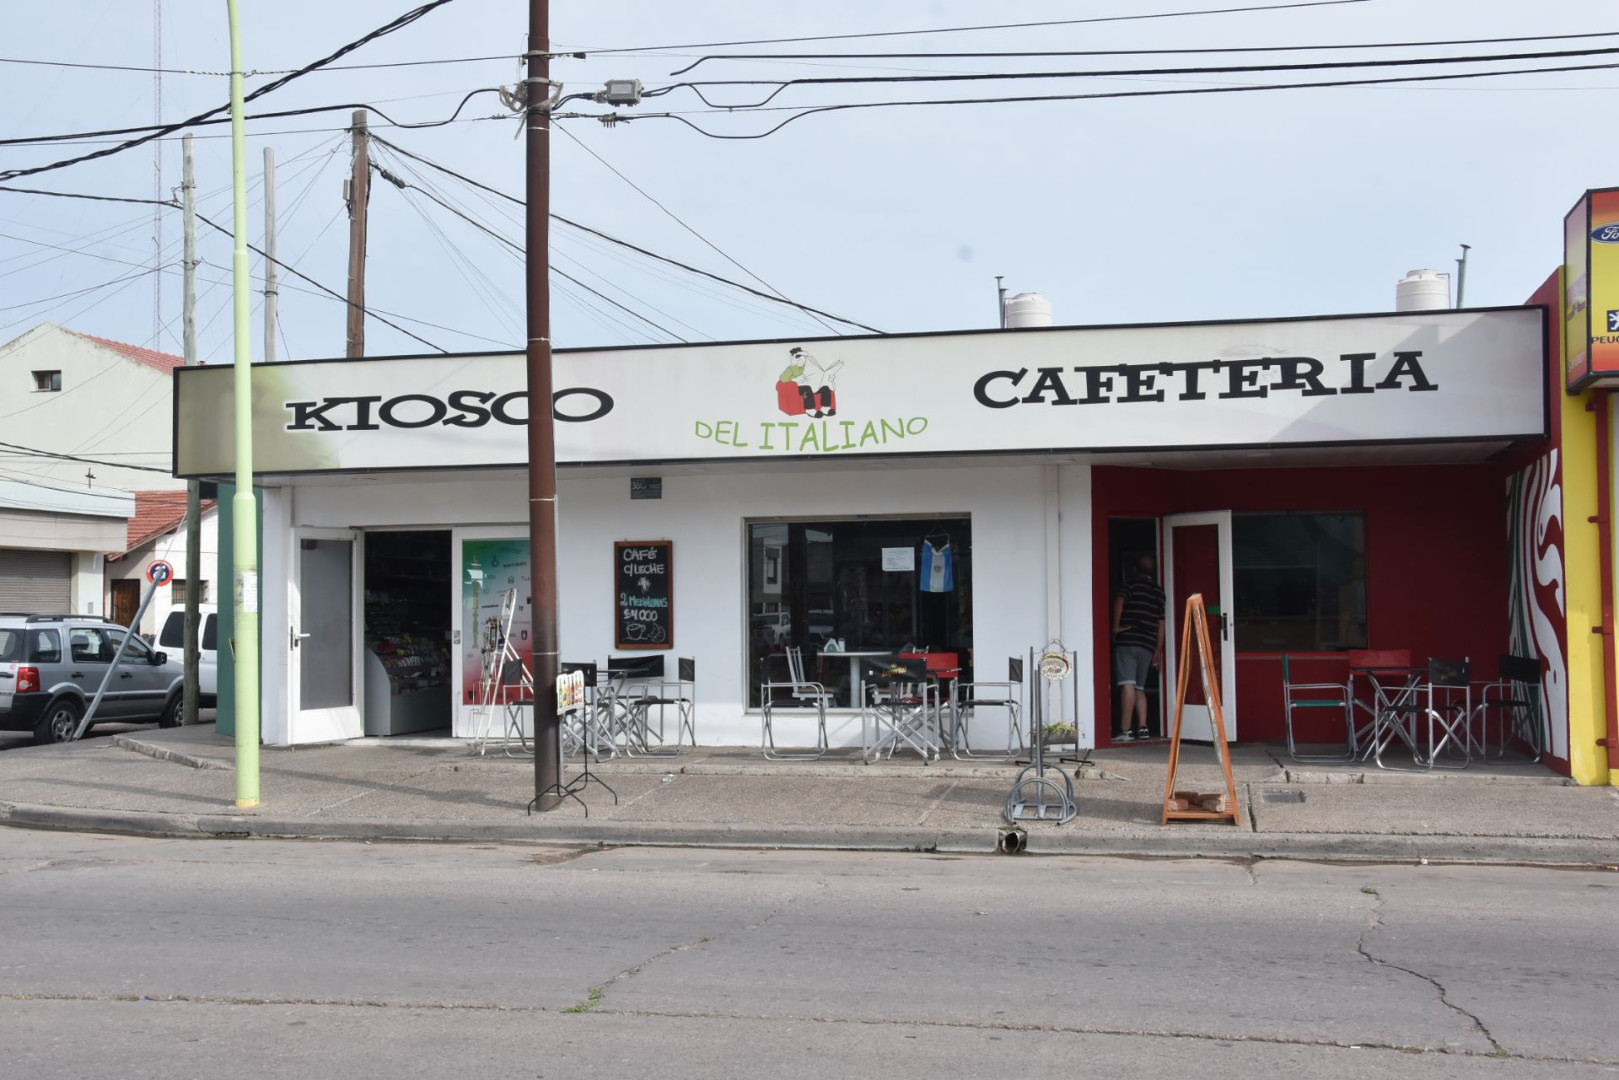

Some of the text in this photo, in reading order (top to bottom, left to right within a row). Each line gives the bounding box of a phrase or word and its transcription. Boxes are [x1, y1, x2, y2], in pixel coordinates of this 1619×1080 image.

[973, 350, 1439, 409] CAFETERIA
[695, 417, 928, 452] DEL ITALIANO
[620, 592, 628, 607] 2
